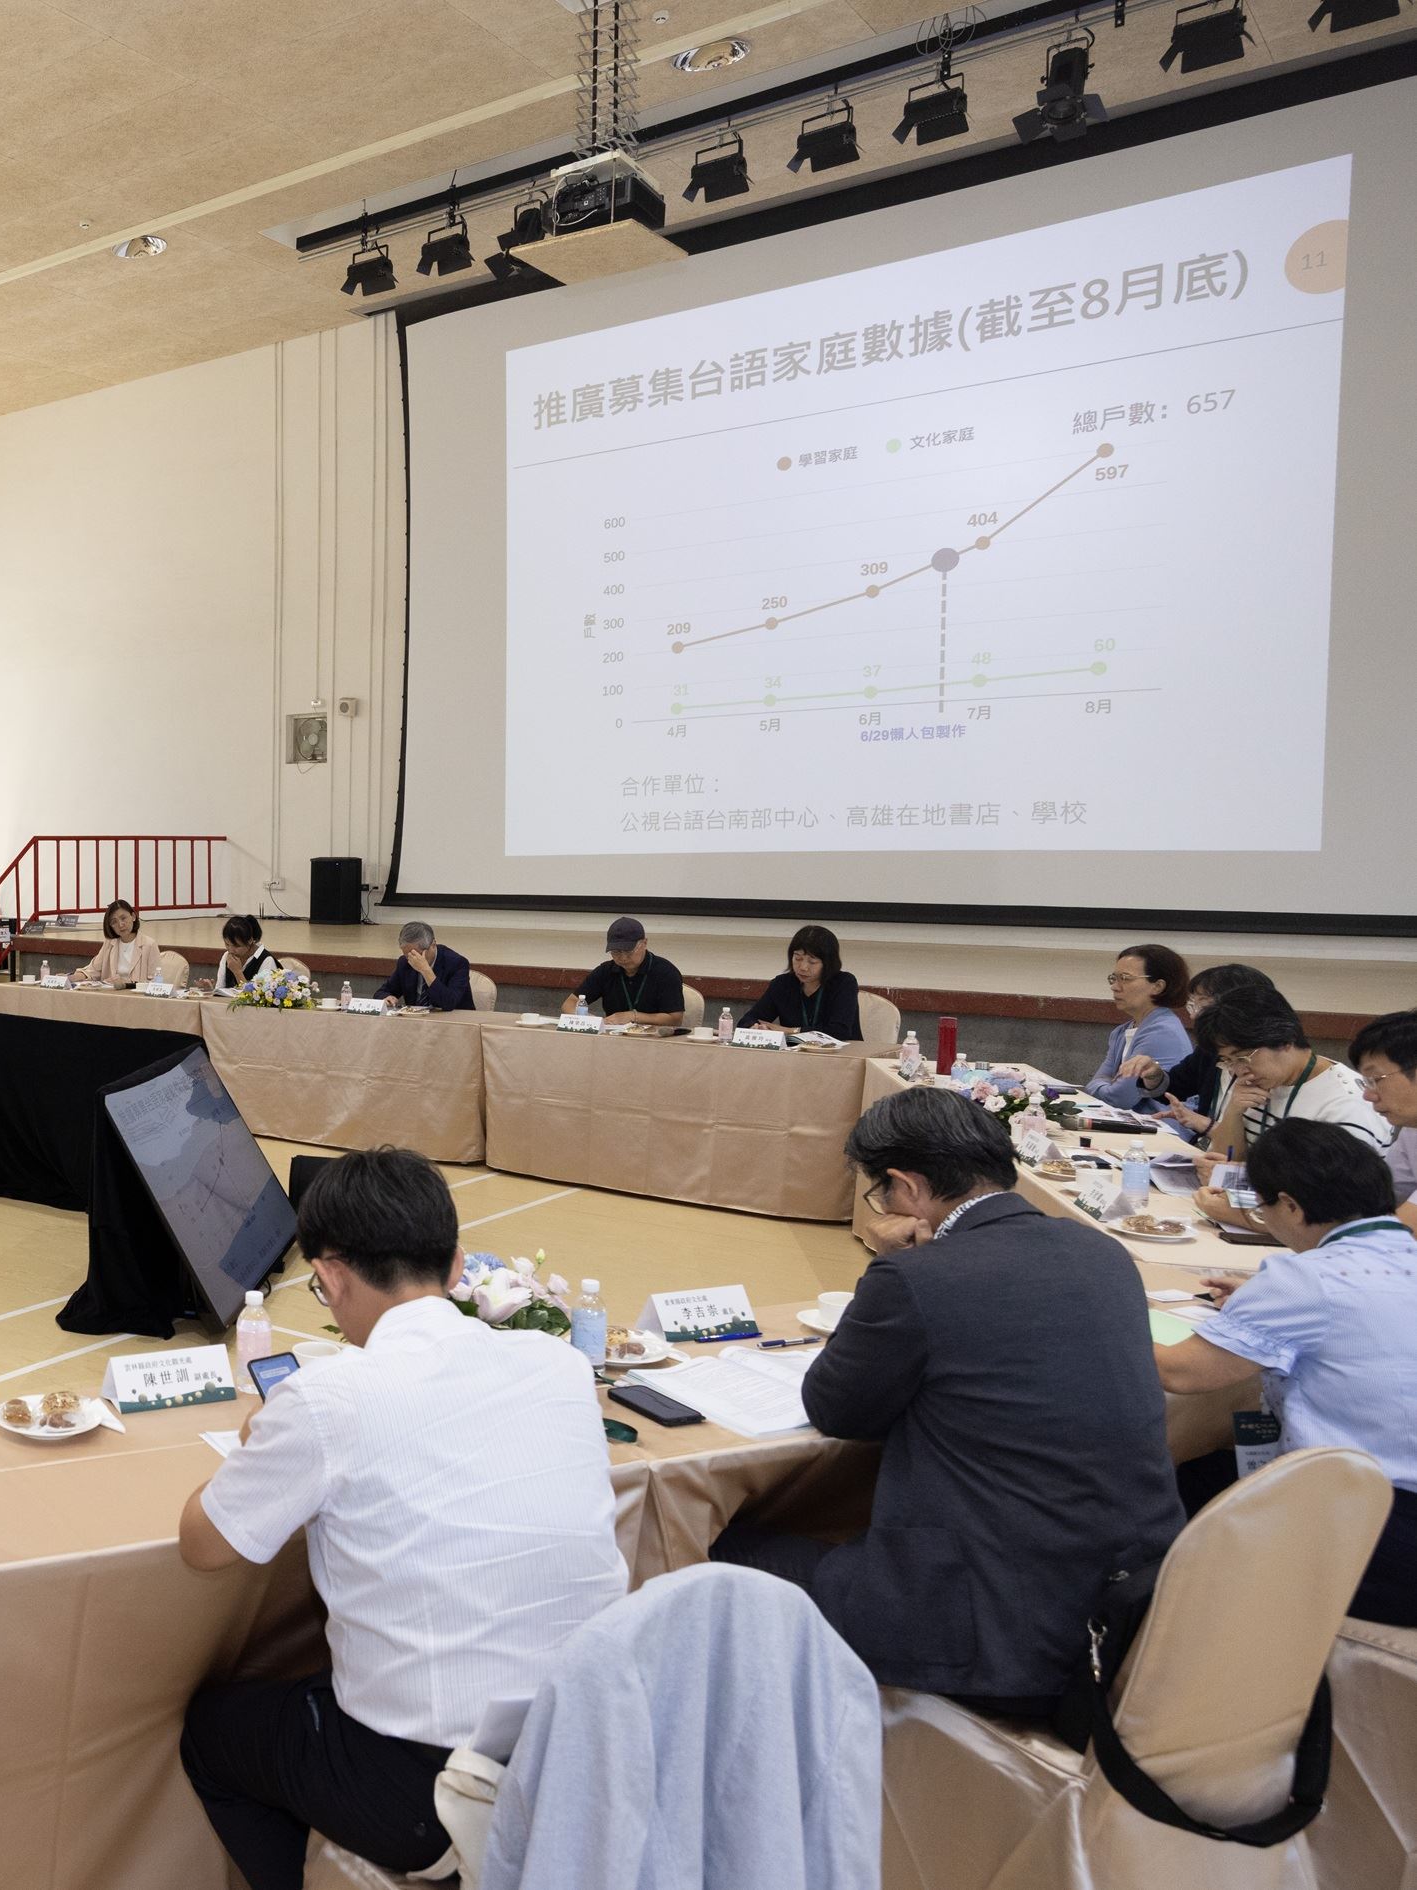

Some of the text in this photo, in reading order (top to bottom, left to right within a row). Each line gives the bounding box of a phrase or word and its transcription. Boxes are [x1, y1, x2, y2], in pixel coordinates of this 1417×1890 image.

[1301, 250, 1327, 270] 11
[533, 249, 1249, 431] 推廣募集台語家庭數據(截至8月底)
[1186, 389, 1236, 415] 657
[909, 427, 974, 450] 文化家庭
[798, 446, 858, 468] 學習家庭
[1095, 464, 1129, 481] 597
[604, 516, 626, 529] 600
[967, 511, 999, 527] 404
[603, 550, 625, 563] 500
[860, 561, 888, 577] 309
[603, 584, 625, 596] 400
[761, 596, 788, 610] 250
[603, 617, 624, 630] 300
[666, 622, 691, 635] 209
[1094, 638, 1116, 653] 60
[602, 651, 624, 664] 200
[971, 651, 992, 665] 48
[863, 664, 882, 677] 37
[764, 675, 782, 689] 34
[602, 684, 624, 697] 100
[673, 683, 689, 697] 31
[967, 705, 991, 720] 7月
[1085, 698, 1112, 715] 8月
[615, 718, 623, 729] 0
[759, 718, 781, 732] 5月
[858, 711, 881, 726] 6月
[667, 724, 687, 738] 4月
[860, 723, 967, 742] 6/29懶人包製作
[620, 800, 1088, 833] 公視台語台南部中心、高雄在地書店、學校
[143, 1368, 190, 1387] 陳世訓
